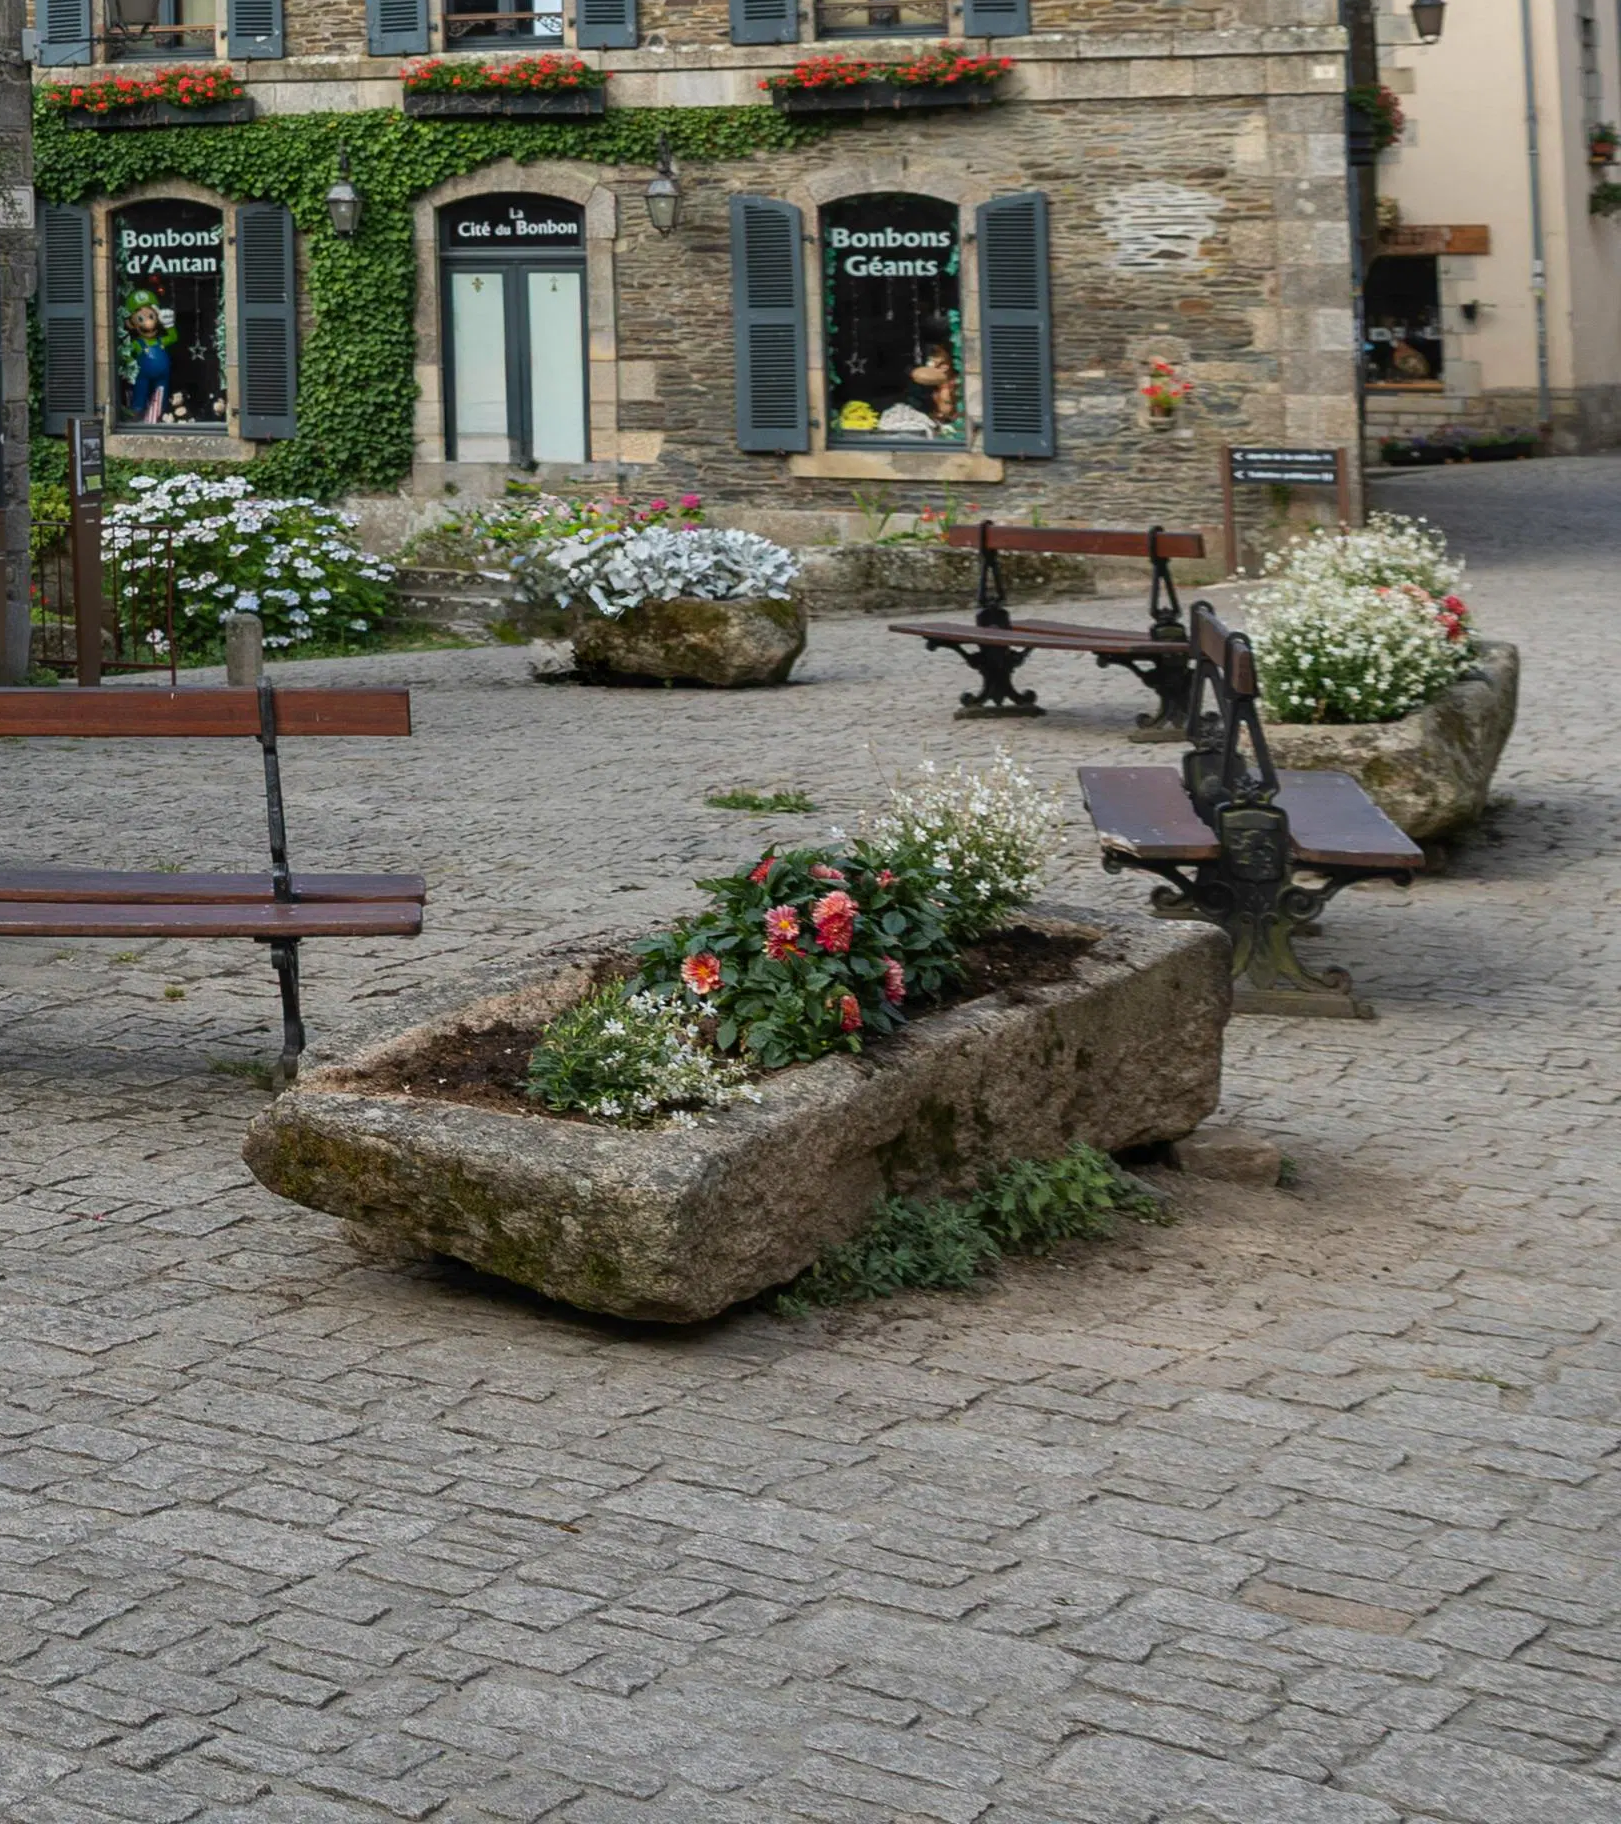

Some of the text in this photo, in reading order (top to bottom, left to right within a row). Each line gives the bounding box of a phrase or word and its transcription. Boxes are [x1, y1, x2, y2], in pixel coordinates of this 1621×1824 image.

[508, 206, 525, 220] La
[121, 227, 220, 249] Bonbons
[457, 218, 578, 237] Cité du Bonbon
[831, 227, 951, 249] Bonbons
[126, 254, 217, 275] d'Antan
[844, 255, 939, 277] Géants
